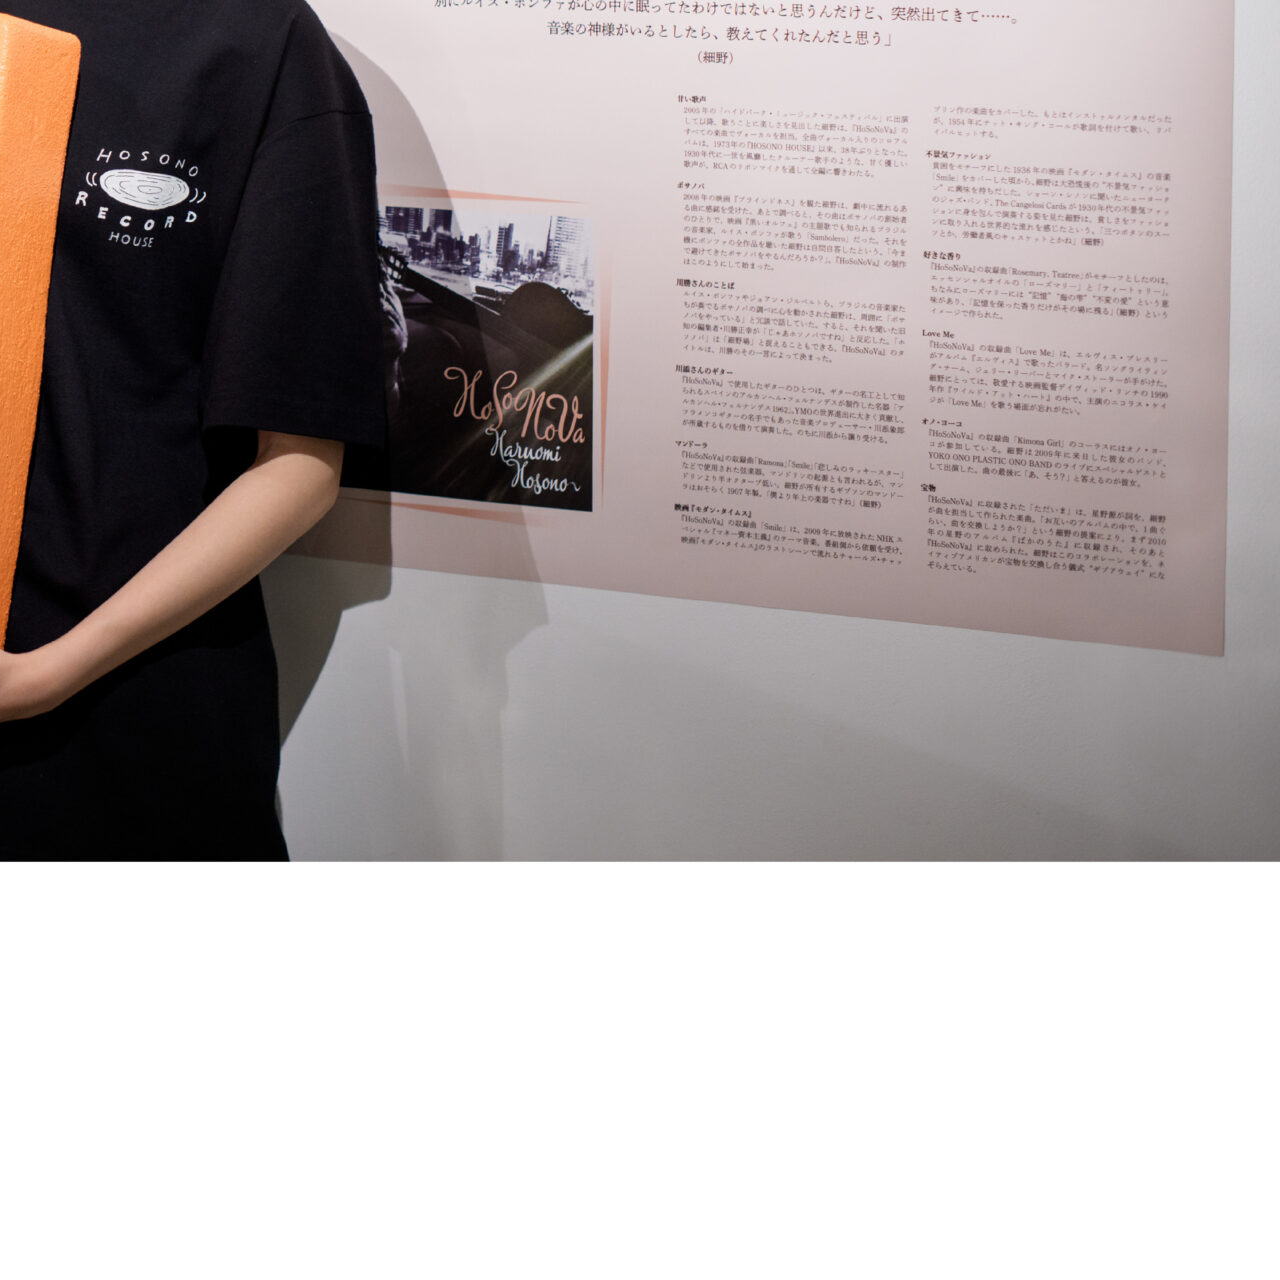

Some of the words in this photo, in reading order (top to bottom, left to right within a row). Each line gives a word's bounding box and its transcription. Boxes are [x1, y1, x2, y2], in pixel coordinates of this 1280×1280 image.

[96, 148, 199, 177] HOSONO
[75, 191, 198, 231] RECORD
[108, 231, 154, 248] HOUSE
[922, 329, 940, 337] Love
[485, 427, 561, 462] Haruomi
